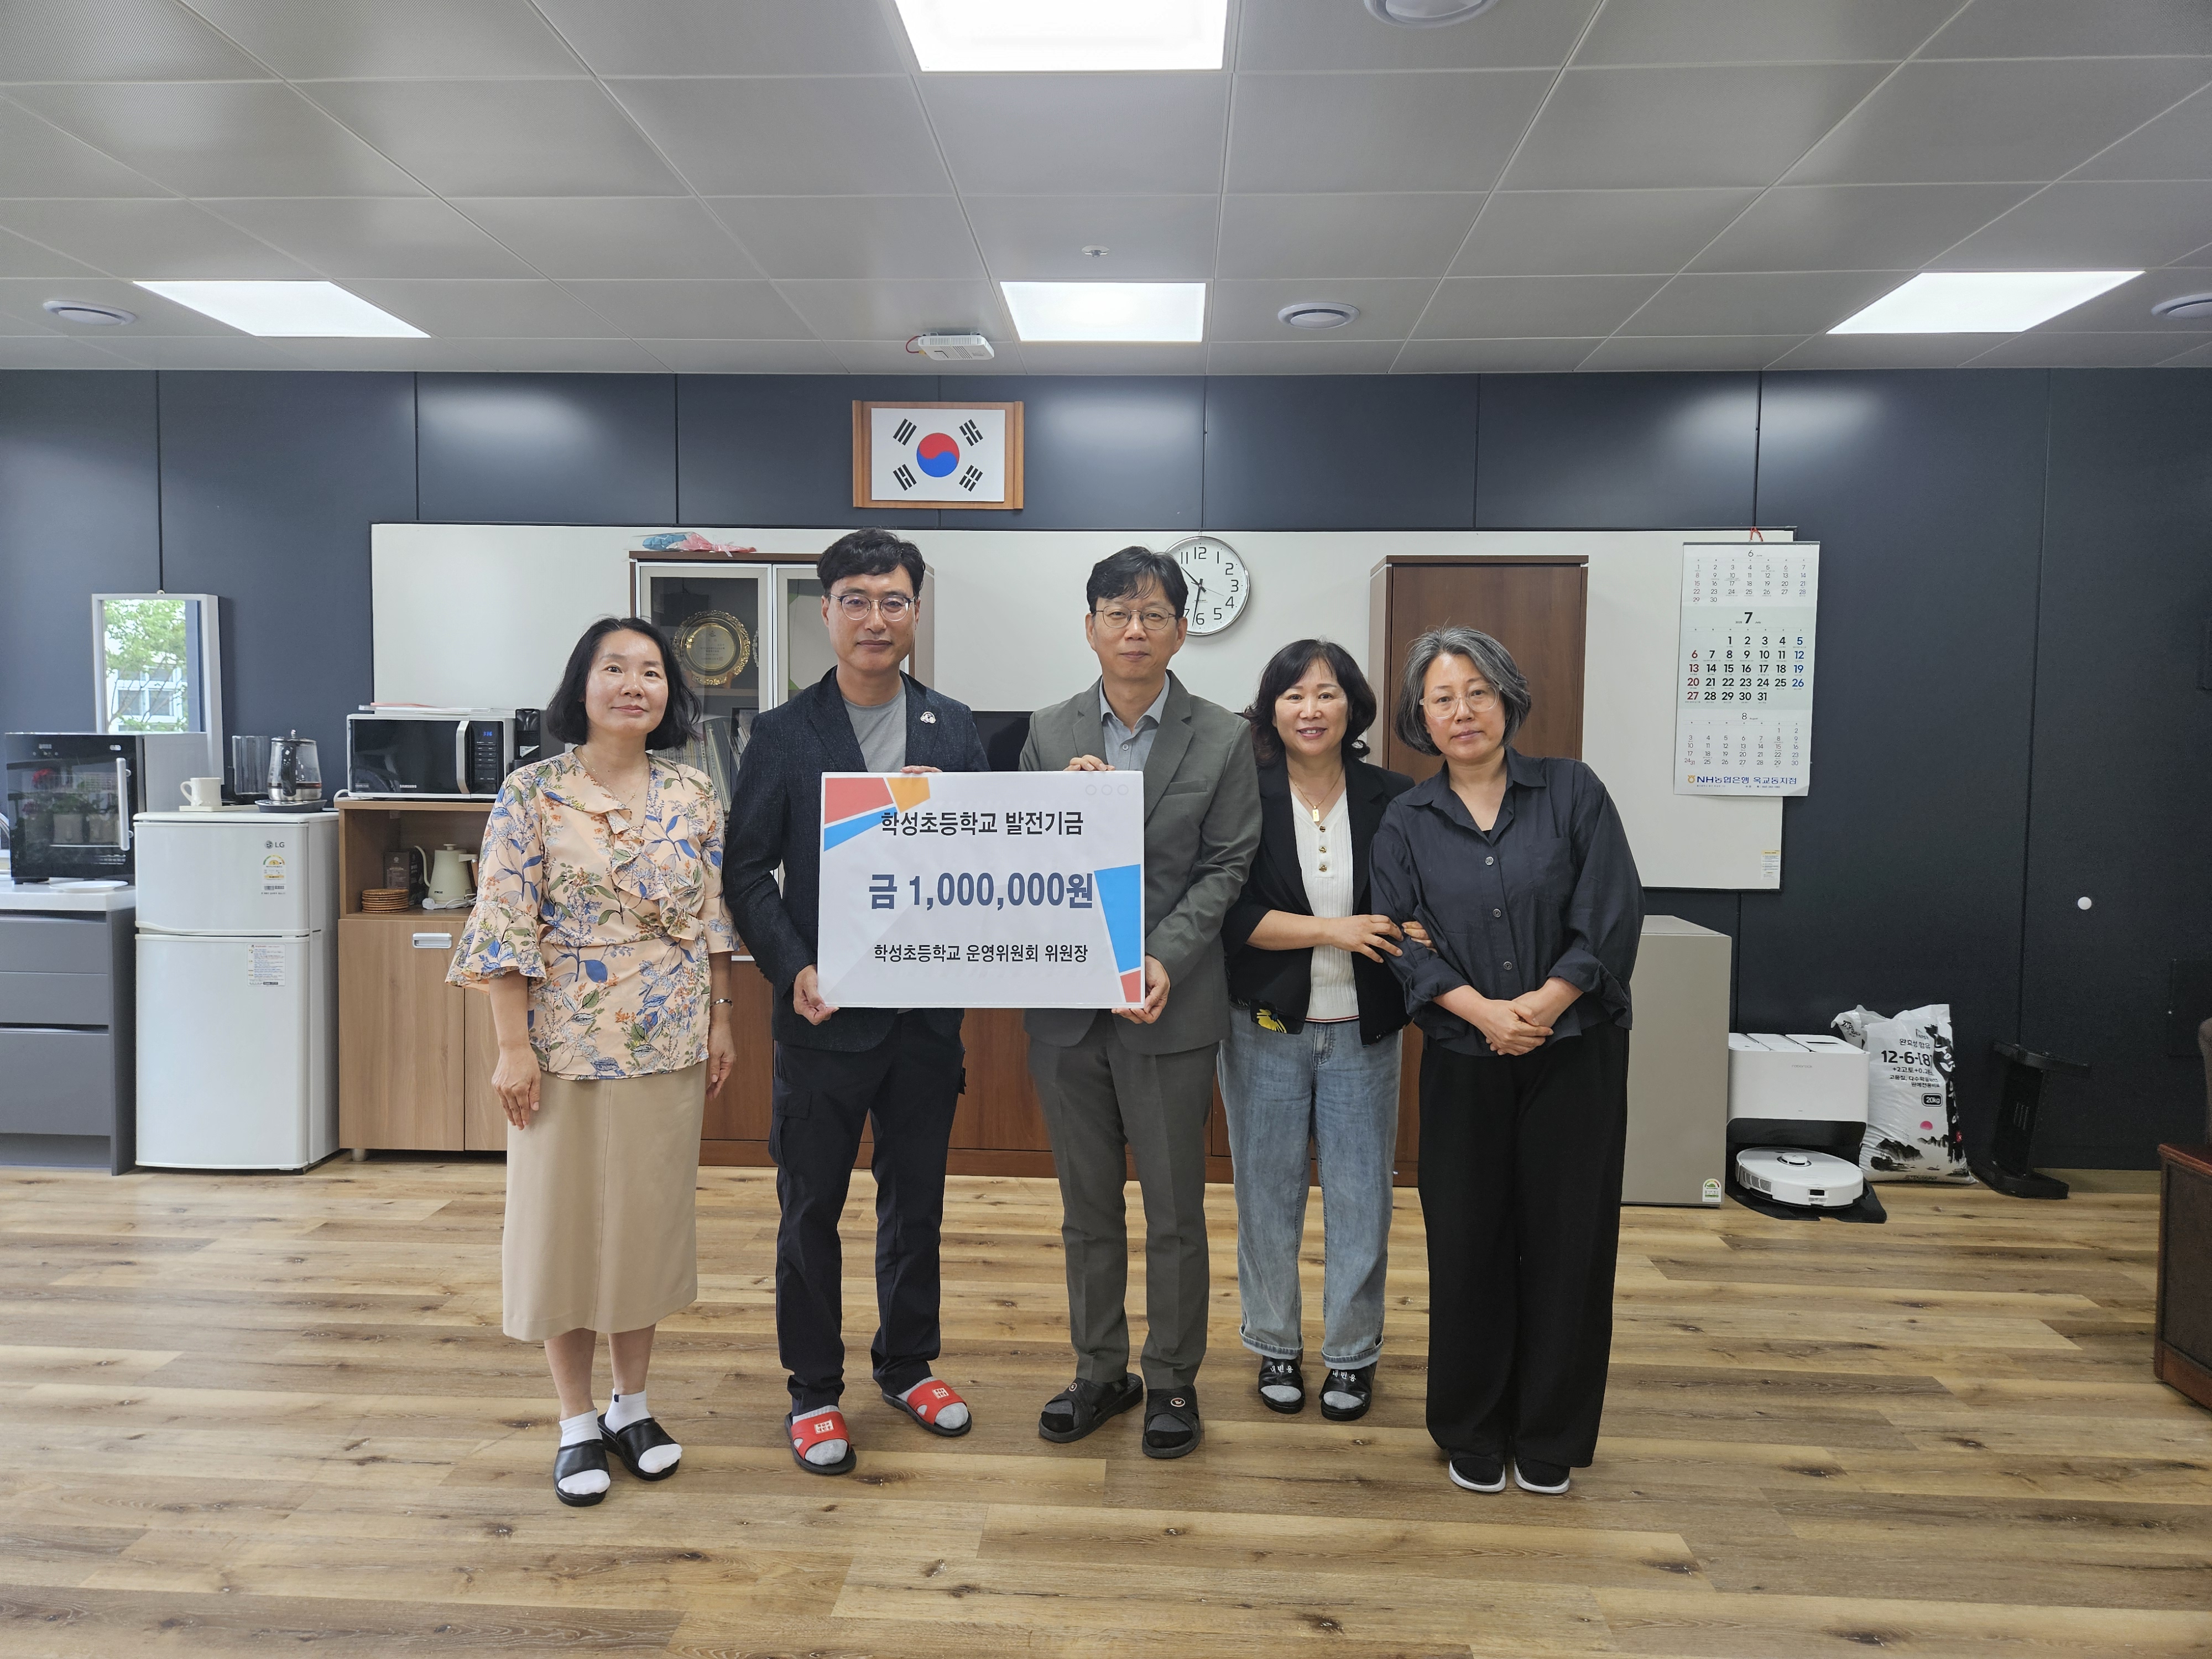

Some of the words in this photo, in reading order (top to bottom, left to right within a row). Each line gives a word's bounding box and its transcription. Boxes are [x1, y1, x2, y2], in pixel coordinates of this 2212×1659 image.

[1181, 551, 1188, 565] 11
[1194, 546, 1207, 560] 12
[1217, 551, 1219, 564] 1
[1225, 562, 1234, 575] 2
[1230, 579, 1239, 592] 3
[1225, 596, 1234, 609] 4
[1196, 613, 1205, 625] 6
[1213, 607, 1222, 620] 5
[1744, 612, 1753, 624] 7
[1728, 636, 1732, 645] 1
[1744, 636, 1751, 645] 2
[1761, 636, 1768, 645] 3
[1779, 637, 1786, 645] 4
[1797, 637, 1803, 645] 5
[1691, 650, 1698, 659] 6
[1709, 650, 1715, 659] 7
[1726, 650, 1733, 659] 8
[1744, 650, 1750, 659] 9
[1759, 650, 1770, 659] 10
[1778, 650, 1786, 659] 11
[1794, 650, 1804, 659] 12
[1689, 664, 1699, 673] 13
[1706, 664, 1717, 673] 14
[1724, 664, 1734, 673] 15
[1741, 664, 1751, 673] 16
[1759, 664, 1769, 673] 17
[1776, 664, 1787, 674] 18
[1793, 665, 1804, 674] 19
[1687, 677, 1700, 686] 20
[1705, 677, 1715, 686] 21
[1722, 677, 1734, 686] 22
[1739, 677, 1752, 687] 23
[1757, 678, 1770, 687] 24
[1775, 678, 1787, 687] 25
[1792, 678, 1804, 687] 26
[1687, 691, 1699, 700] 27
[1704, 691, 1717, 701] 28
[1721, 691, 1734, 701] 29
[1739, 692, 1752, 701] 30
[1757, 692, 1767, 701] 31
[1697, 776, 1749, 784] NH농협은행
[881, 811, 998, 836] 학성초등학교
[1006, 811, 1083, 836] 발전기금
[869, 874, 898, 909] 금
[909, 872, 1093, 911] 1,000,000원
[874, 944, 961, 962] 학성초등학교
[966, 944, 1039, 962] 운영위원회
[1045, 944, 1088, 962] 위원장
[1899, 1039, 1918, 1048] 완효성
[1270, 1364, 1293, 1374] 내빈용
[1332, 1369, 1357, 1382] 내빈용
